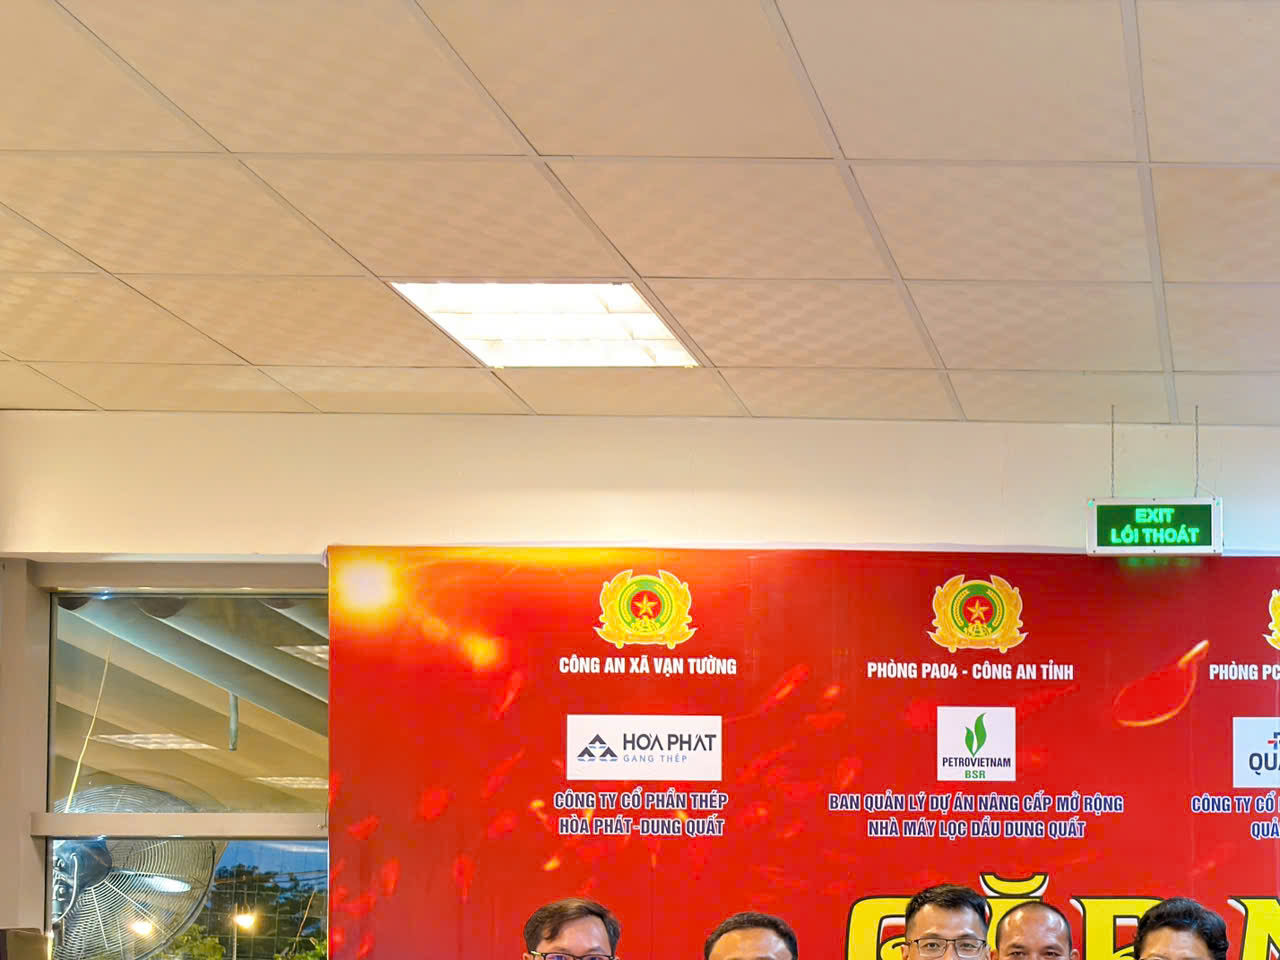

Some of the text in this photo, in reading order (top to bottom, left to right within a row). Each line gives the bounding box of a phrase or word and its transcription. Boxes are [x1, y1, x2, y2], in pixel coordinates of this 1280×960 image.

[1135, 507, 1175, 523] EXIT
[1142, 523, 1200, 544] THOÁT
[559, 654, 737, 677] CÔNG AN XÃ VẠN TƯỜNG
[867, 658, 917, 680] PHÒNG
[921, 663, 958, 679] PA04
[972, 661, 1011, 680] CÔNG
[1016, 664, 1038, 680] AN
[1040, 659, 1074, 681] TỈNH
[1209, 661, 1258, 680] PHÒNG
[623, 753, 688, 763] GANG THÉP
[942, 757, 1011, 768] PETROVIETNAM
[964, 770, 986, 780] BSR
[554, 789, 595, 809] CÔNG
[600, 792, 618, 809] TY
[621, 787, 642, 809] CỔ
[690, 790, 728, 809] THÉP
[829, 789, 1124, 816] BAN QUẢN LÝ DỰ ÁN NÂNG CẤP MỞ RỘNG
[1191, 792, 1232, 813] CÔNG
[1234, 795, 1252, 813] TY
[1255, 790, 1276, 813] CỔ
[559, 814, 589, 835] HÒA
[686, 814, 724, 837] QUẤT
[868, 817, 900, 836] NHÀ
[903, 817, 936, 837] MÁY
[940, 820, 967, 840] LỌC
[1004, 820, 1045, 837] DUNG
[1048, 816, 1086, 839] QUẤT
